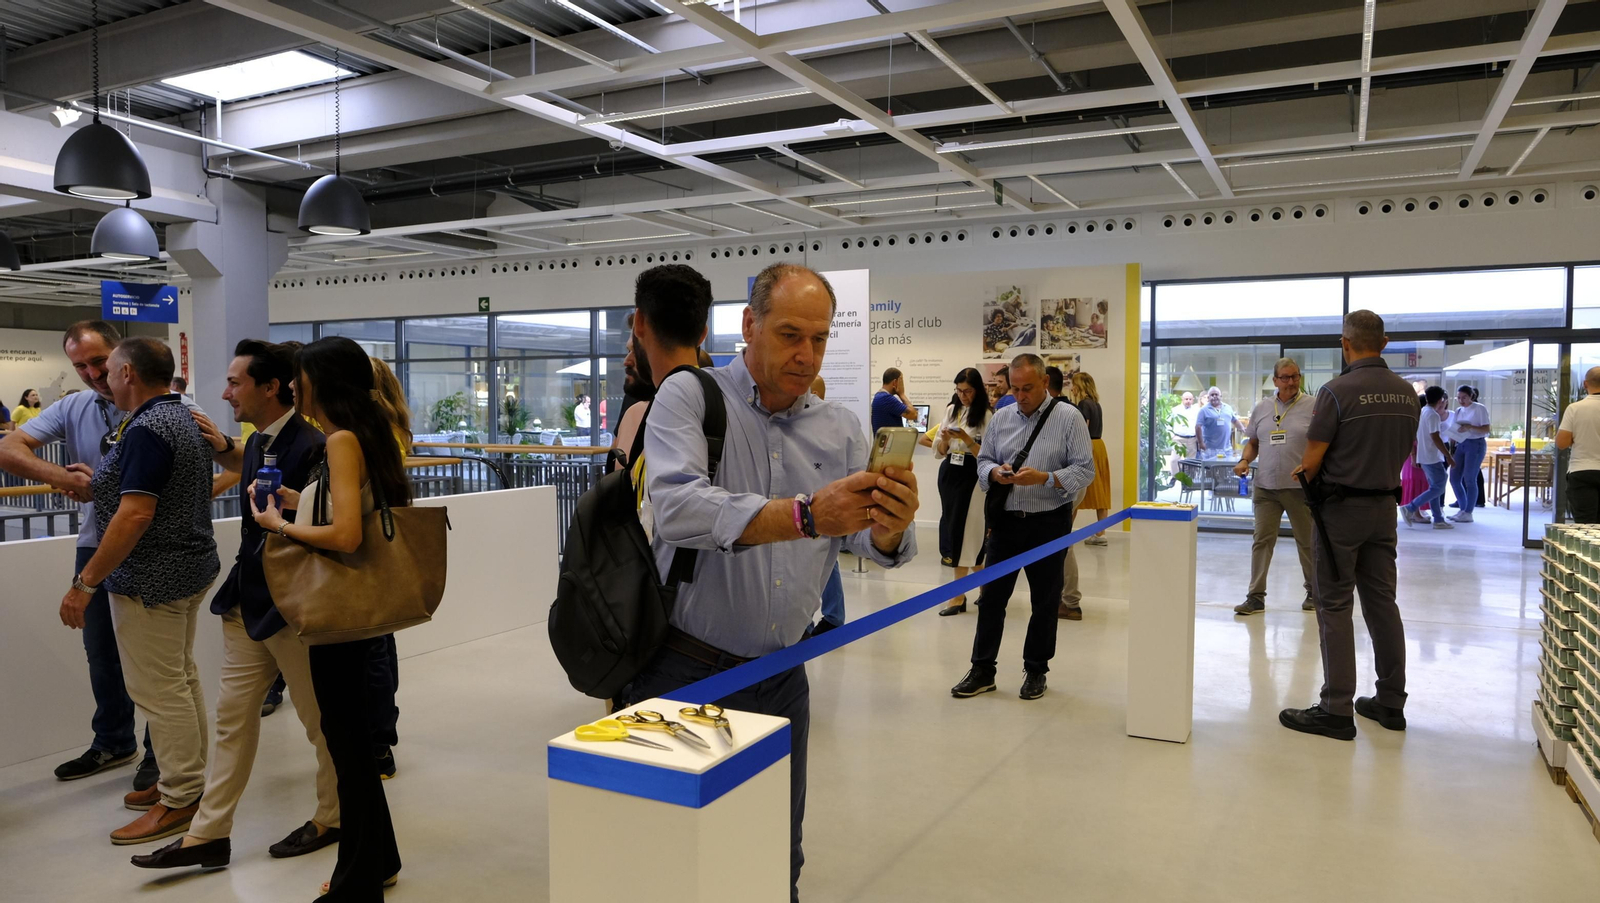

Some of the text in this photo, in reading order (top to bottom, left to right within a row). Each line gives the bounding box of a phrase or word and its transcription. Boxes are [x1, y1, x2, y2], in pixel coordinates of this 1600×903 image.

[870, 300, 902, 314] amily
[904, 318, 914, 328] al
[918, 316, 942, 328] club
[870, 334, 912, 345] da más
[1359, 394, 1415, 406] SECURITAS
